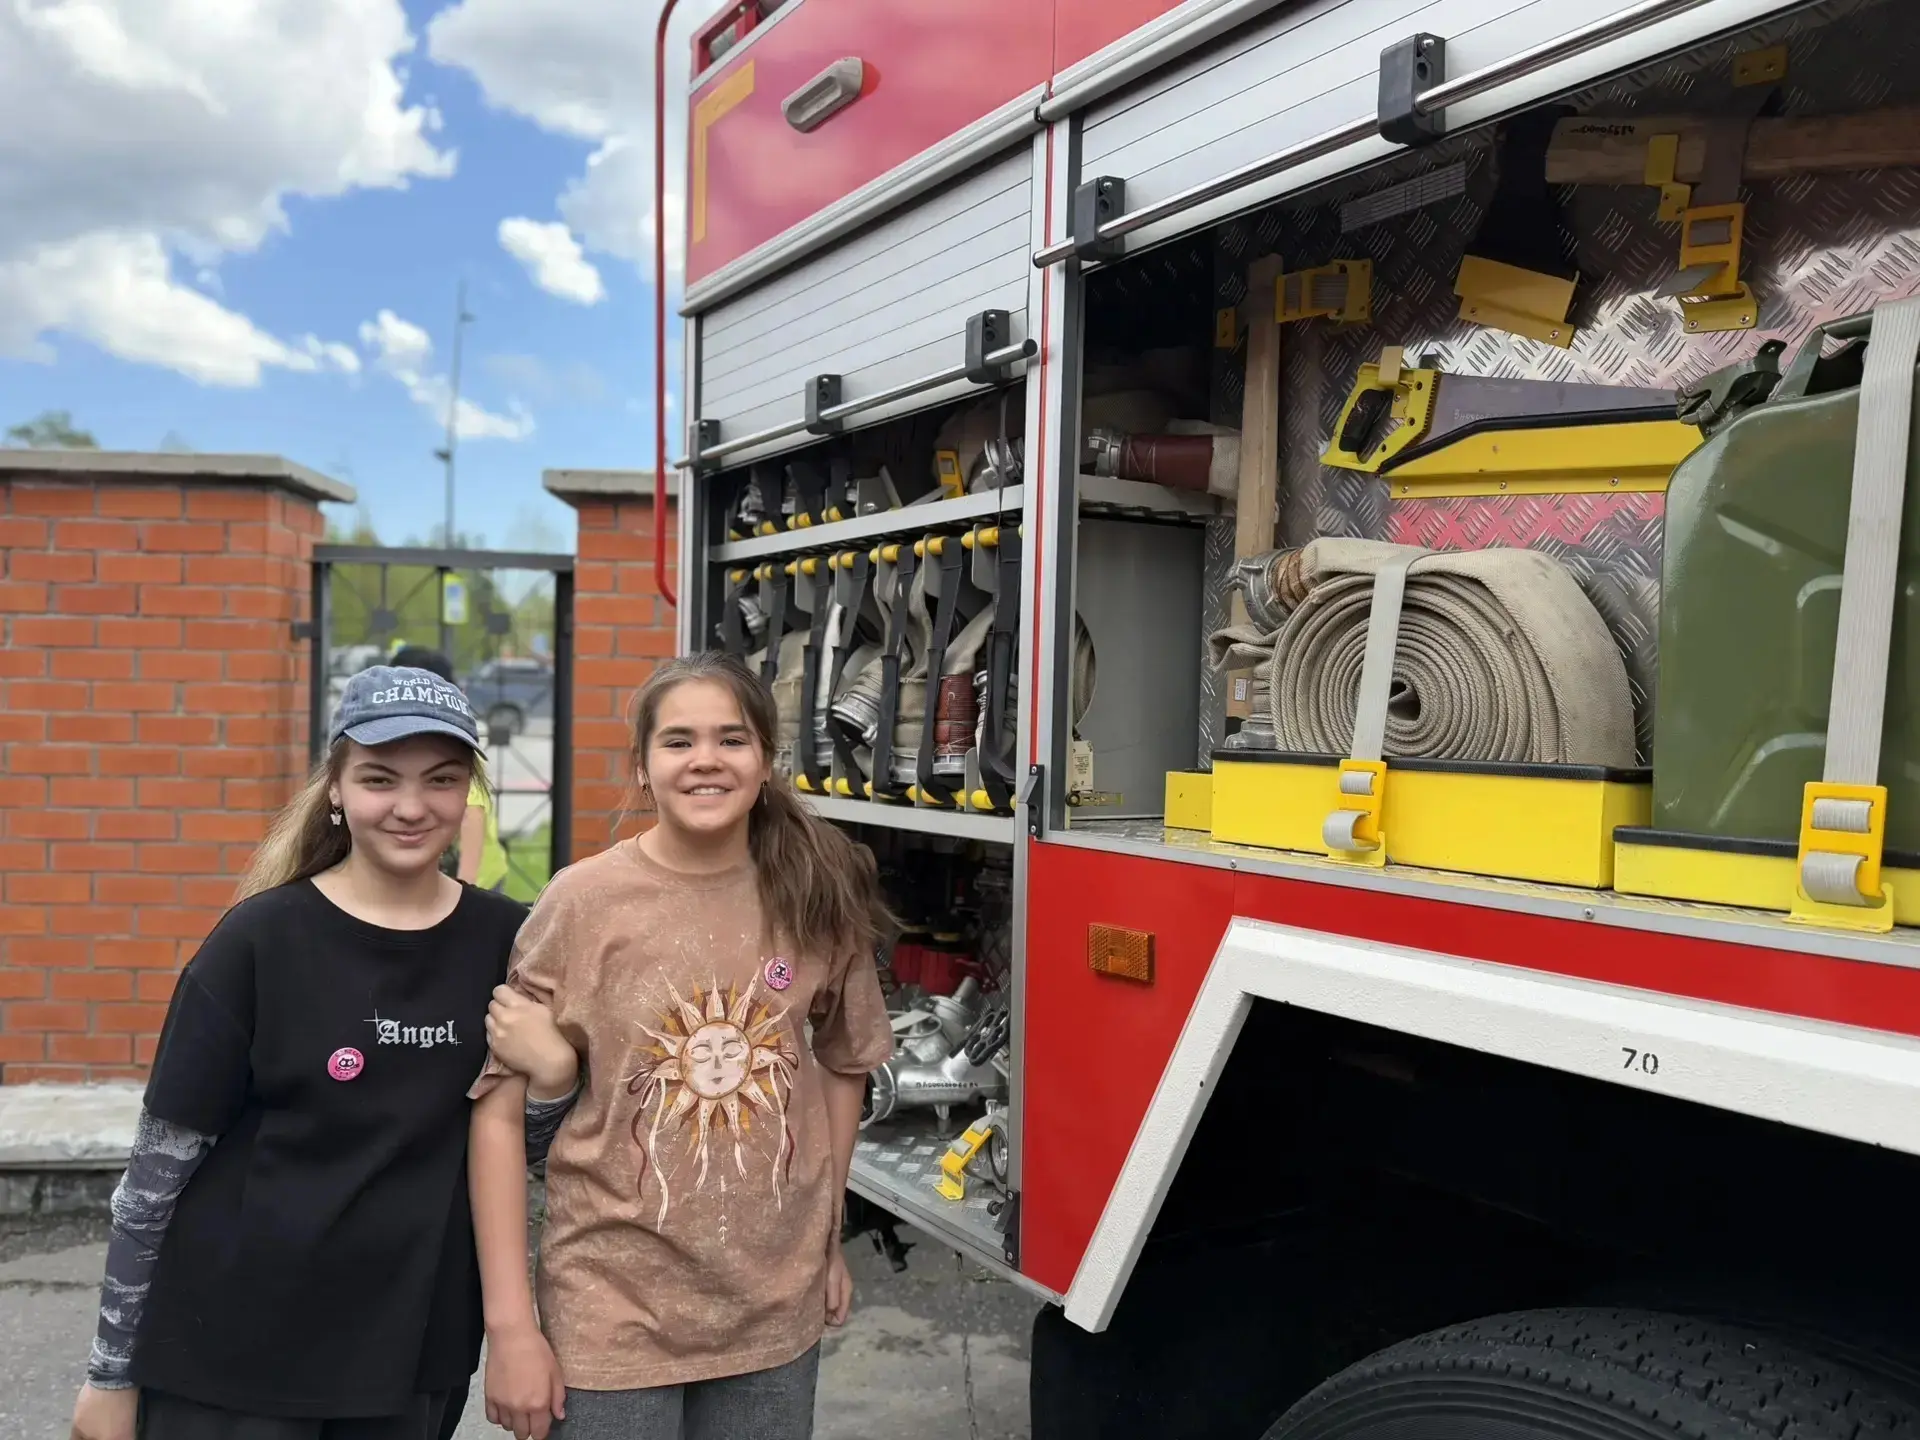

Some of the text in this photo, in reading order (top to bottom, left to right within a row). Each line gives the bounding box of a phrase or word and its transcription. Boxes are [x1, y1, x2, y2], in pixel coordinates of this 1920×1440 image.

[392, 677, 430, 686] WORLD
[377, 1019, 457, 1048] Angel
[1622, 1047, 1659, 1075] 7.0
